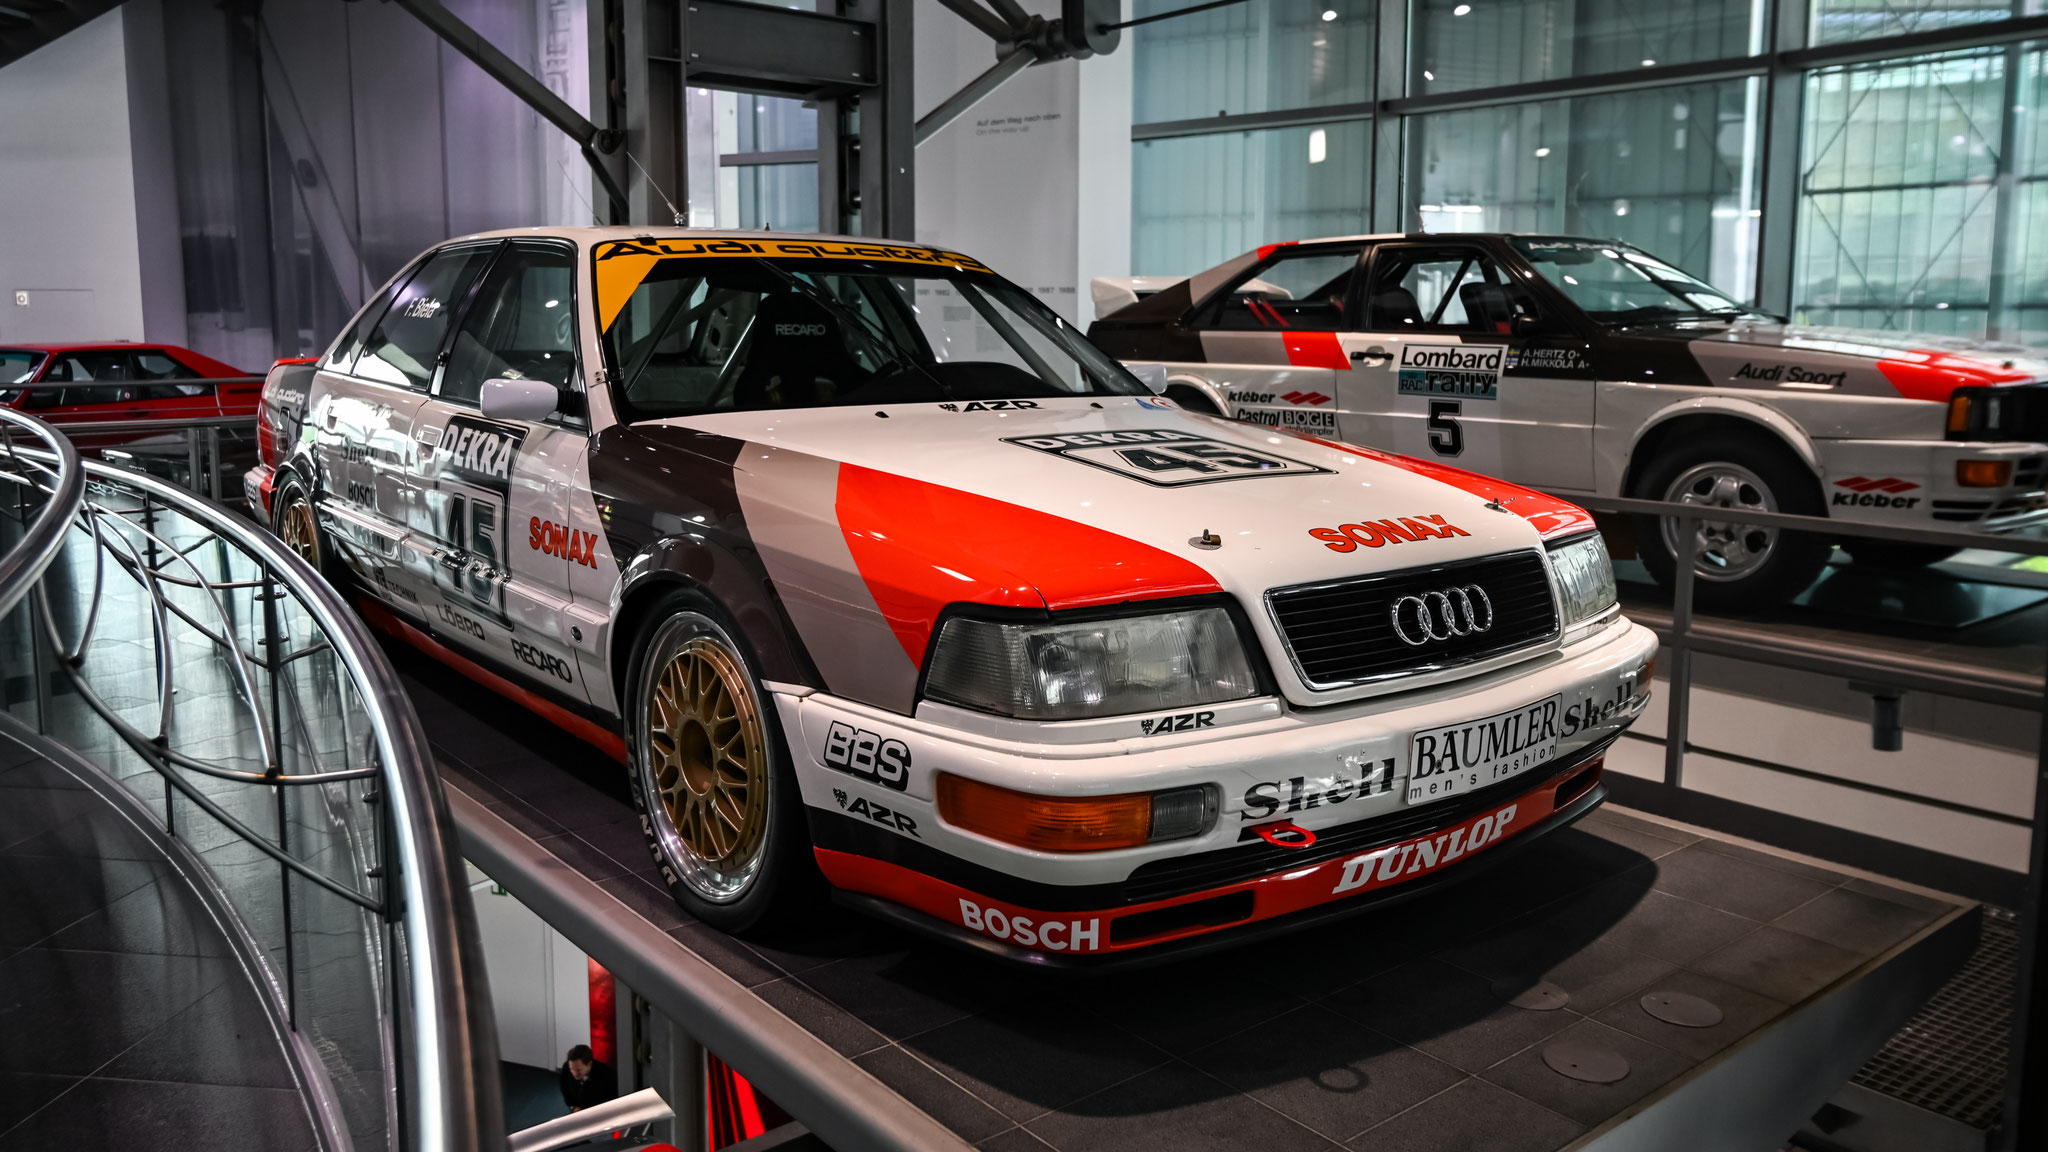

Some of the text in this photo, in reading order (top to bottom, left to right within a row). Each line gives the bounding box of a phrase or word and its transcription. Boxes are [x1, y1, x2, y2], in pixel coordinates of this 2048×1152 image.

[977, 119, 989, 127] Auf
[990, 118, 1005, 126] dem
[1024, 114, 1041, 122] nach
[1042, 113, 1061, 121] oben
[597, 241, 985, 269] Audi quattro
[775, 324, 826, 336] RECARO
[1400, 346, 1503, 370] Lombard
[1521, 358, 1574, 369] H.MIKKOLA
[1523, 348, 1566, 359] A.HERTZ
[1401, 372, 1495, 395] RAC rally
[1736, 362, 1847, 387] Audi Sport
[963, 400, 1045, 413] AZR
[1237, 408, 1281, 428] Castrol
[1283, 410, 1335, 428] BOGE
[1014, 431, 1202, 450] DEKRA
[1427, 399, 1464, 458] 5
[440, 424, 514, 480] DEKRA
[1112, 444, 1288, 475] 45
[347, 480, 377, 509] BOSCH
[439, 491, 497, 605] 45
[529, 516, 599, 570] SONAX
[1308, 514, 1472, 554] SONAX
[436, 603, 486, 641] LÖBRO
[511, 638, 573, 684] RECARO
[1150, 711, 1216, 735] AZR
[1560, 680, 1632, 740] Shell
[824, 720, 912, 792] BBS
[1411, 700, 1557, 781] BÄUMLER
[1410, 744, 1555, 800] men's fashion
[1240, 757, 1396, 822] Shell
[847, 797, 922, 839] AZR
[1332, 804, 1518, 895] DUNLOP
[958, 898, 1100, 951] BOSCH
